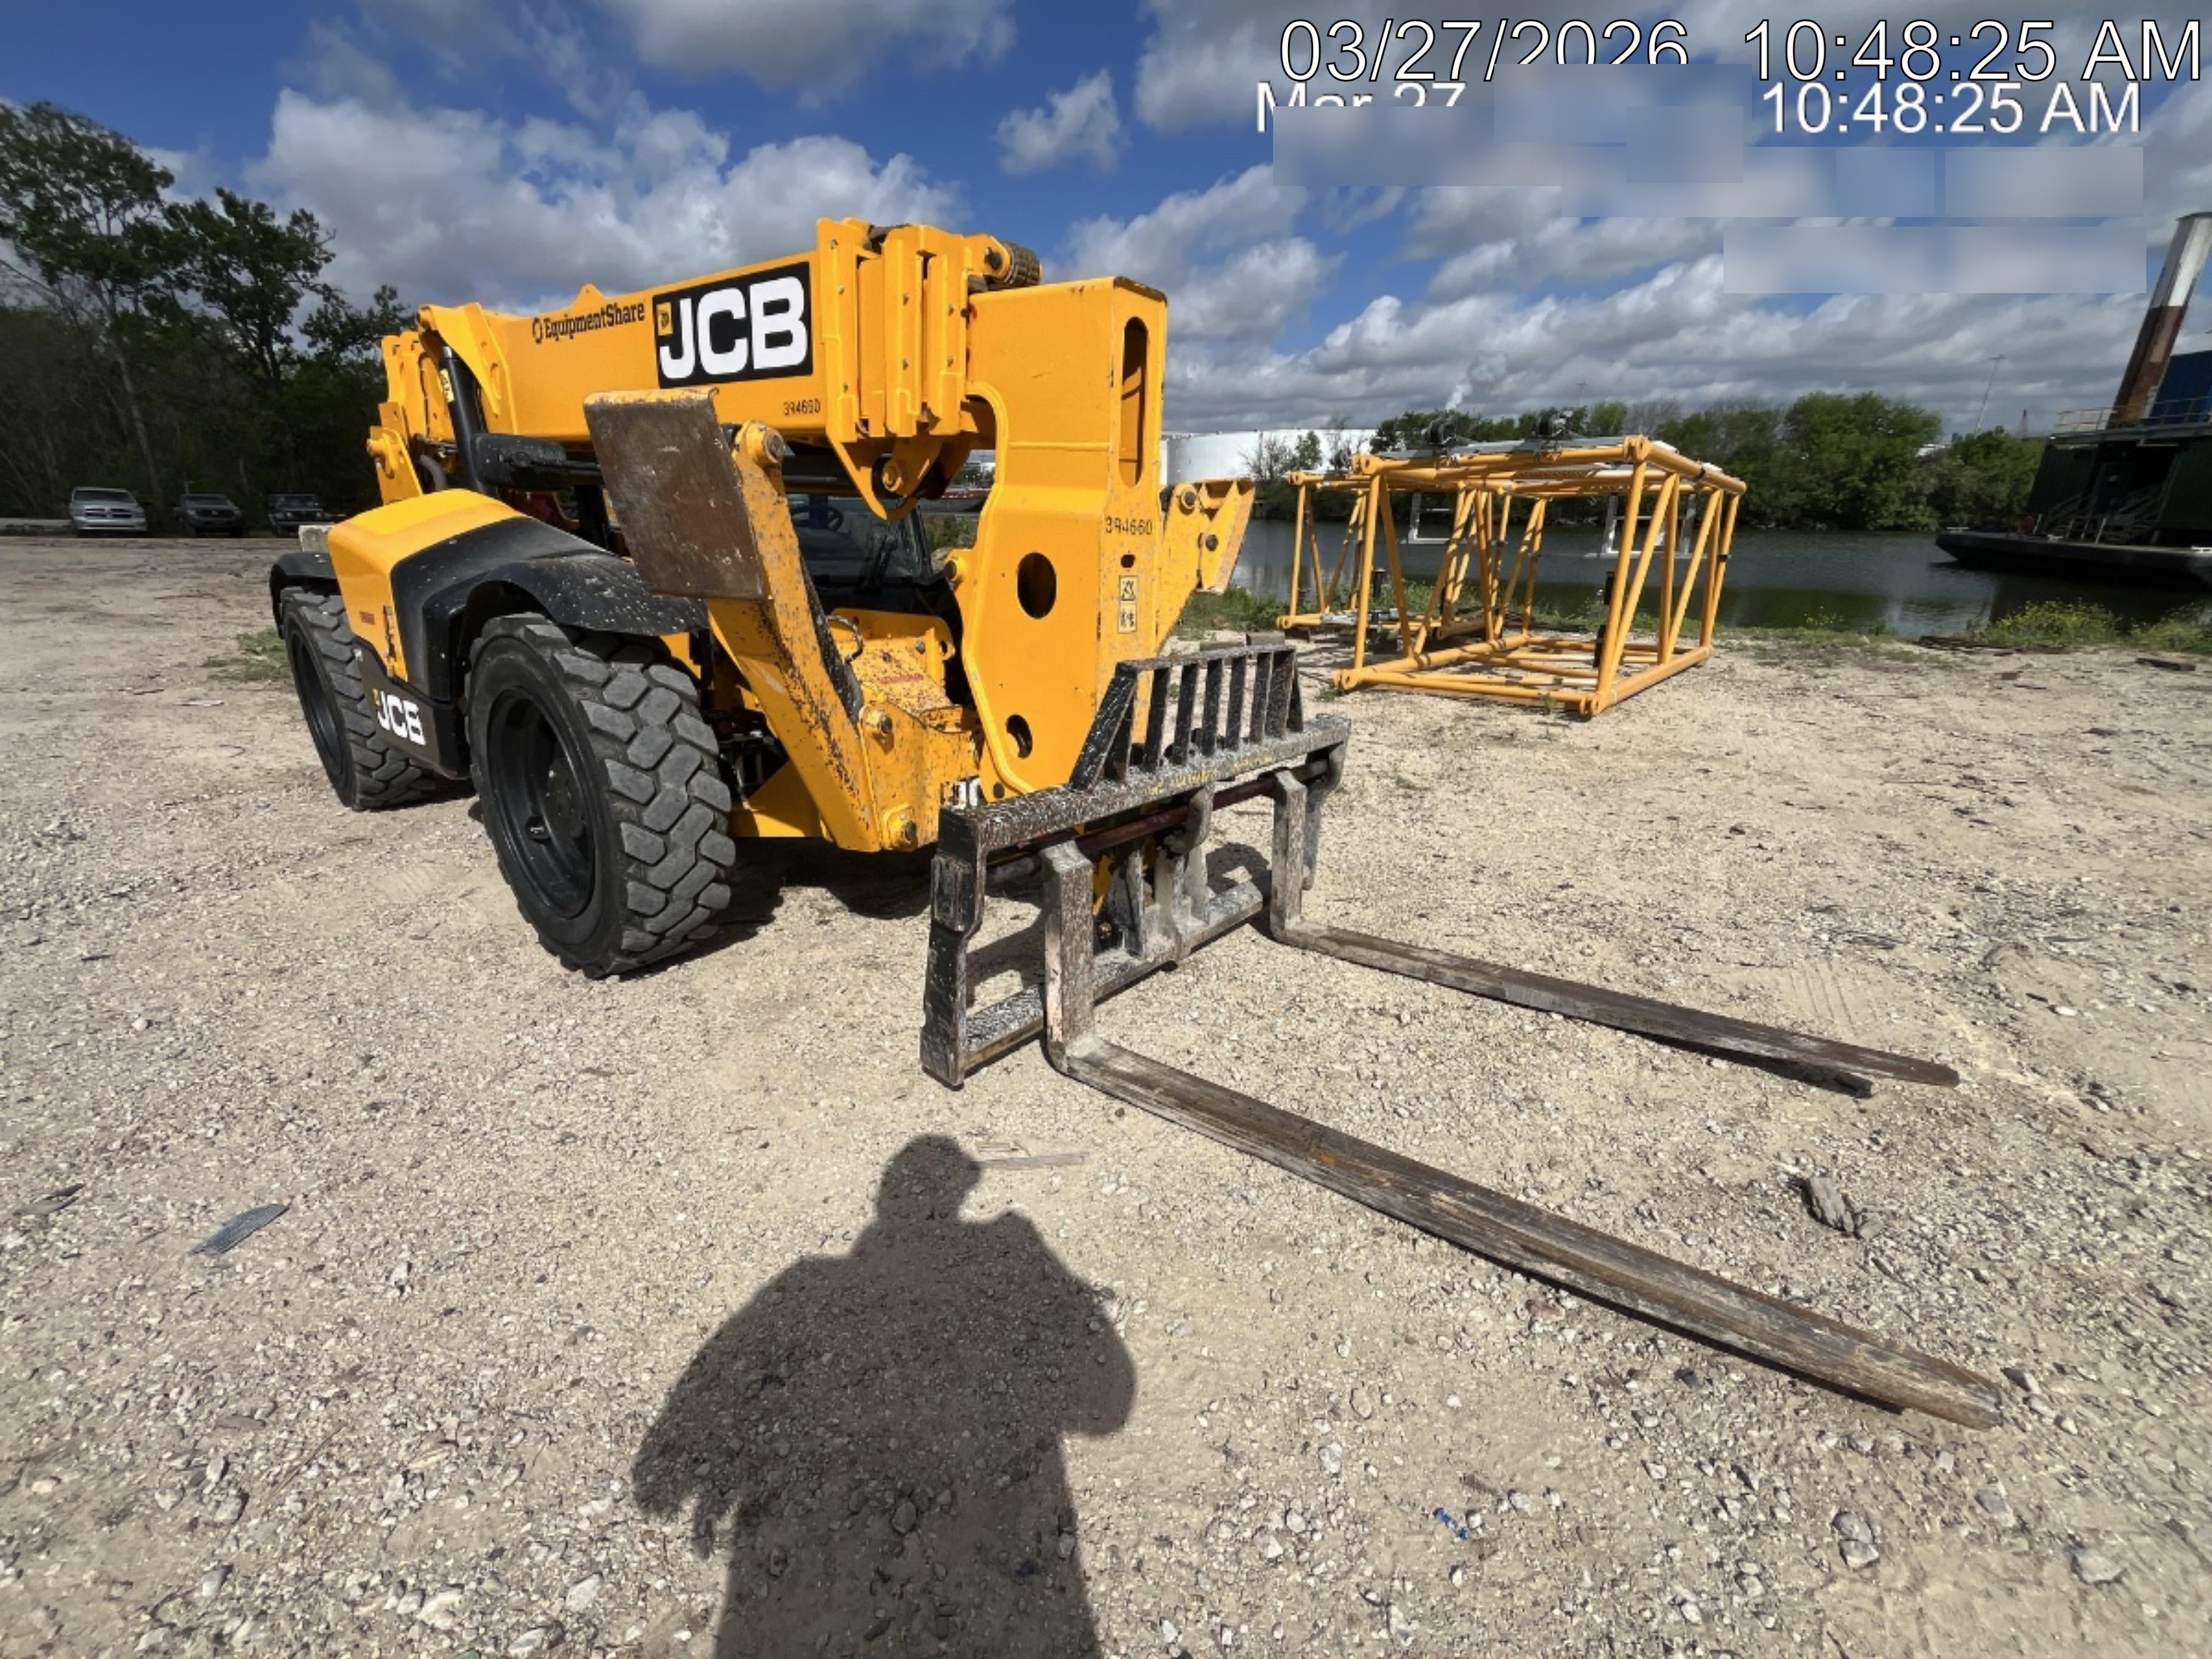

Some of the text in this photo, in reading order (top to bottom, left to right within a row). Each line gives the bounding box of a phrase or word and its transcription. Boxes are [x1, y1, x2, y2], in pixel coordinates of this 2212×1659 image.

[544, 302, 645, 342] EquipmentShare
[659, 276, 808, 379] JCB
[1105, 516, 1153, 535] 394660
[377, 691, 426, 745] JCB
